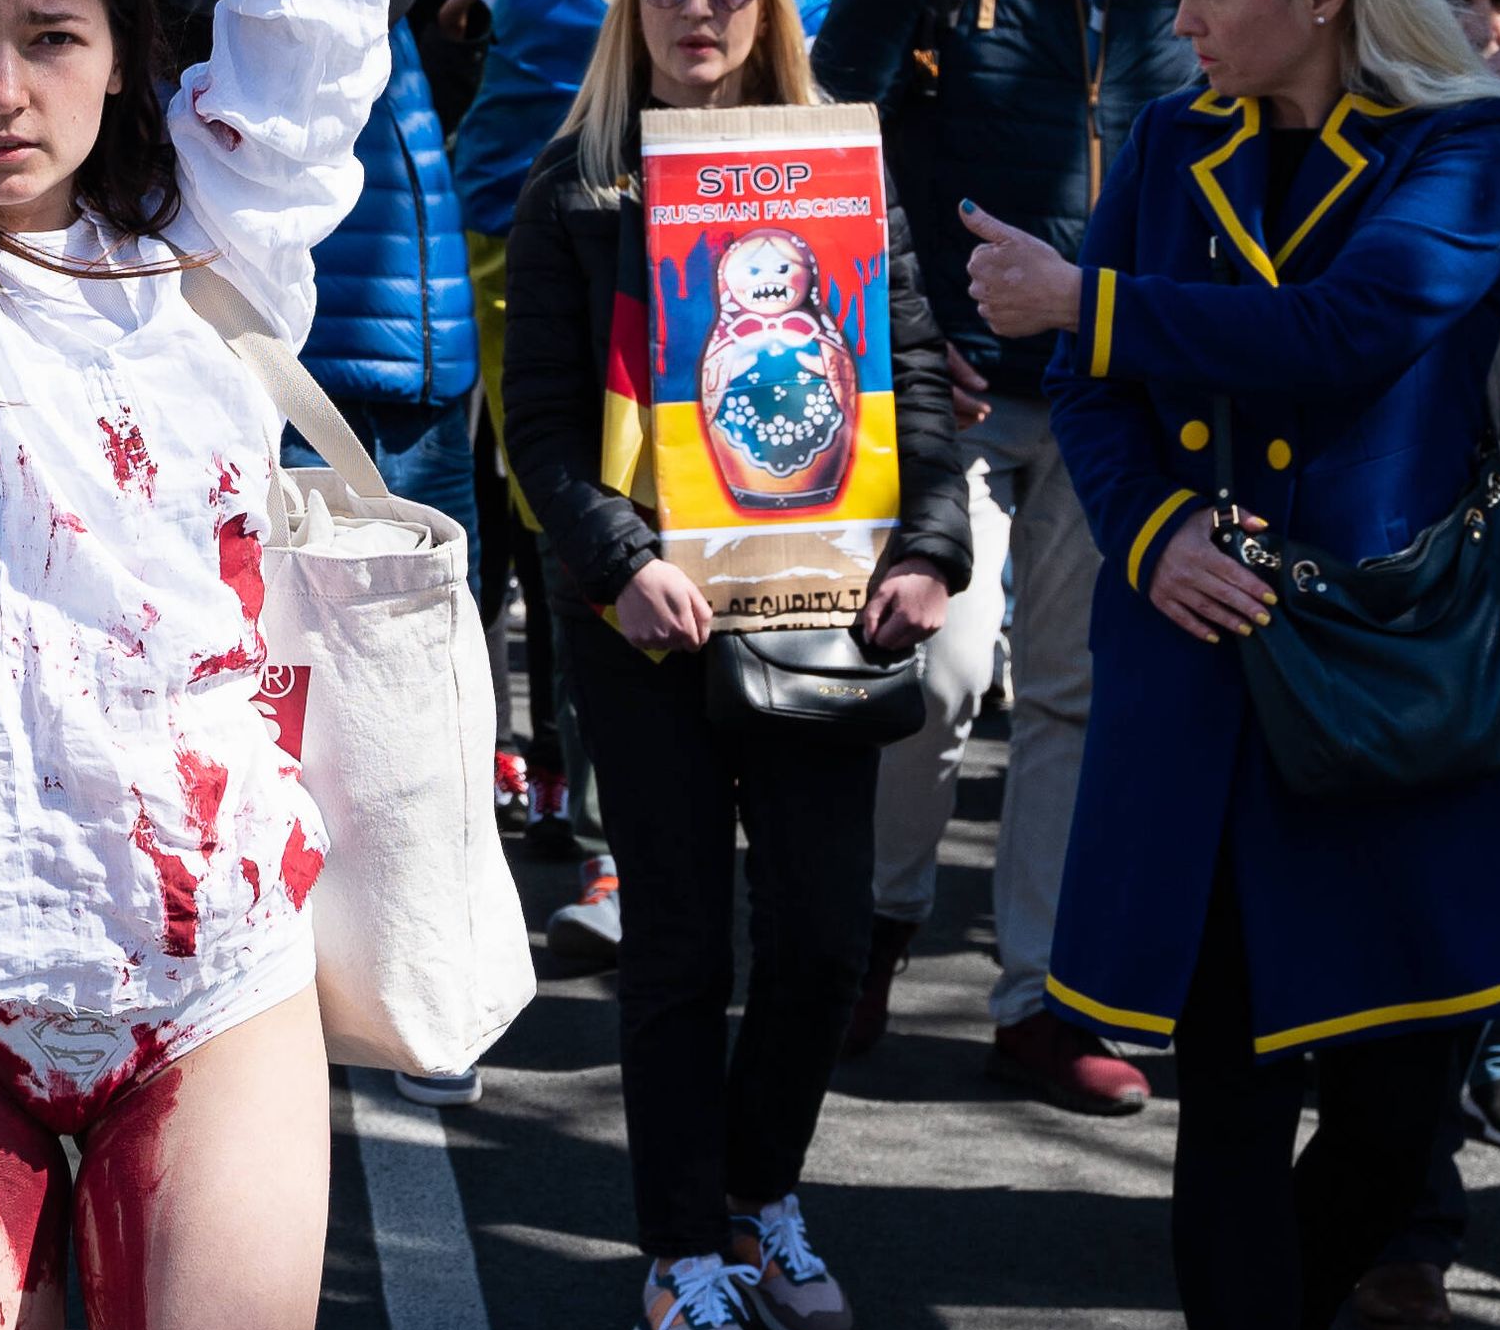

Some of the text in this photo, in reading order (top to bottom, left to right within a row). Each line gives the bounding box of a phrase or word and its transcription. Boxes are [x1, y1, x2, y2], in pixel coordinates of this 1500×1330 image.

[697, 162, 812, 198] STOP
[651, 196, 872, 225] RUSSIAN FASCISM
